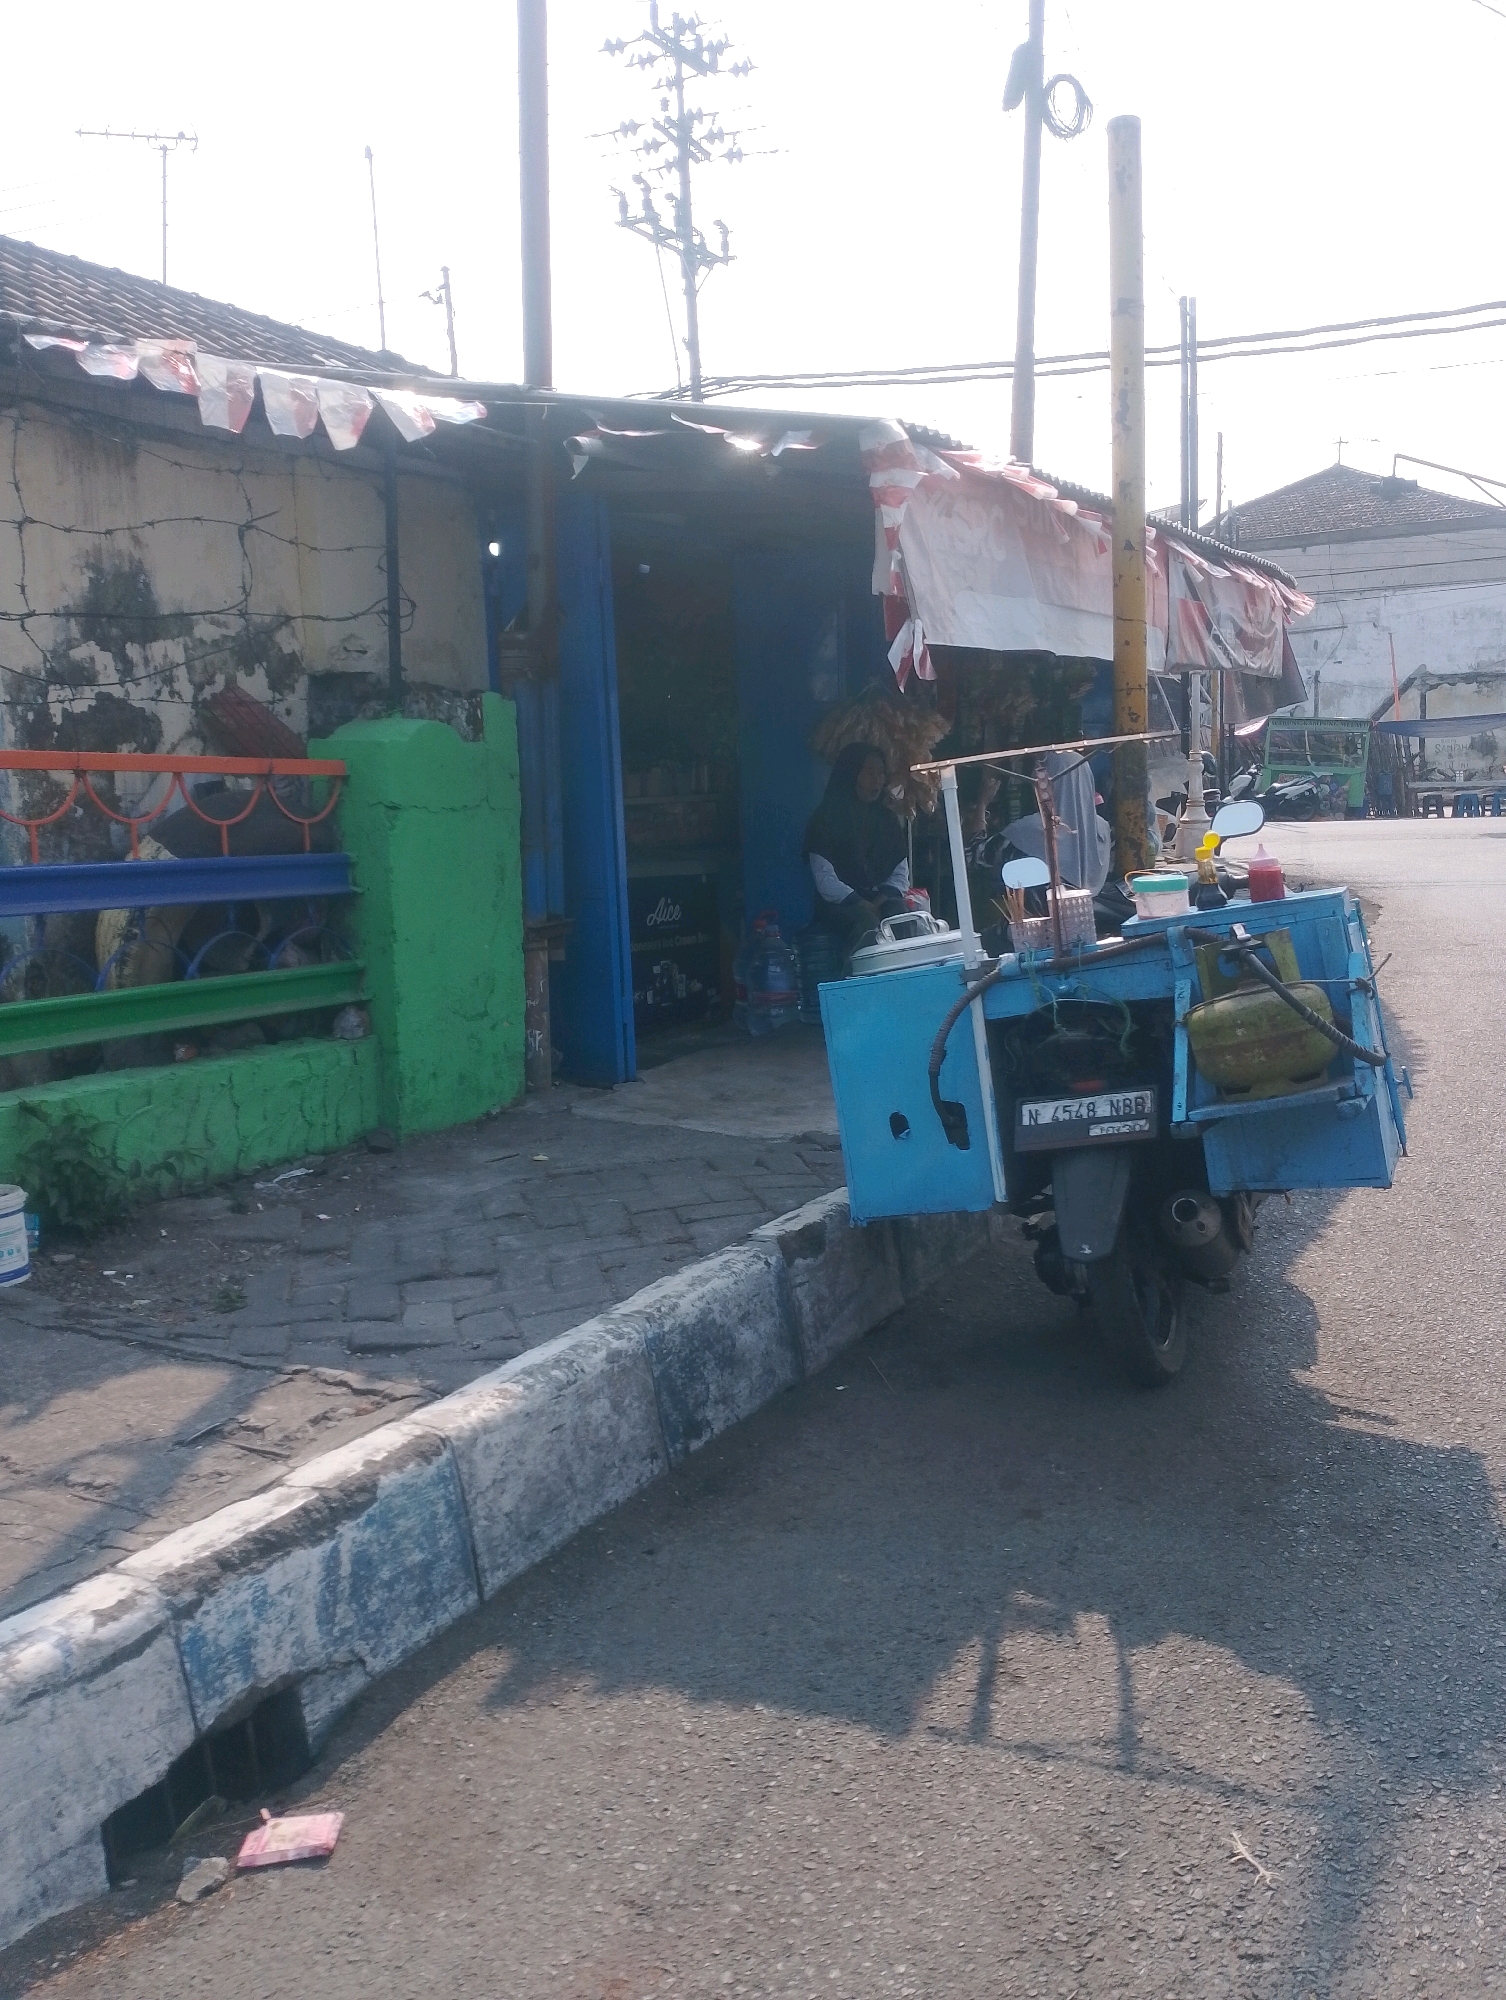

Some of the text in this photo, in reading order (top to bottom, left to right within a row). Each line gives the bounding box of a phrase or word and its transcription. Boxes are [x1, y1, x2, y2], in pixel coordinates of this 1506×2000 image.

[647, 897, 682, 926] Aice
[1028, 1108, 1040, 1126] N
[1051, 1101, 1098, 1122] 4548
